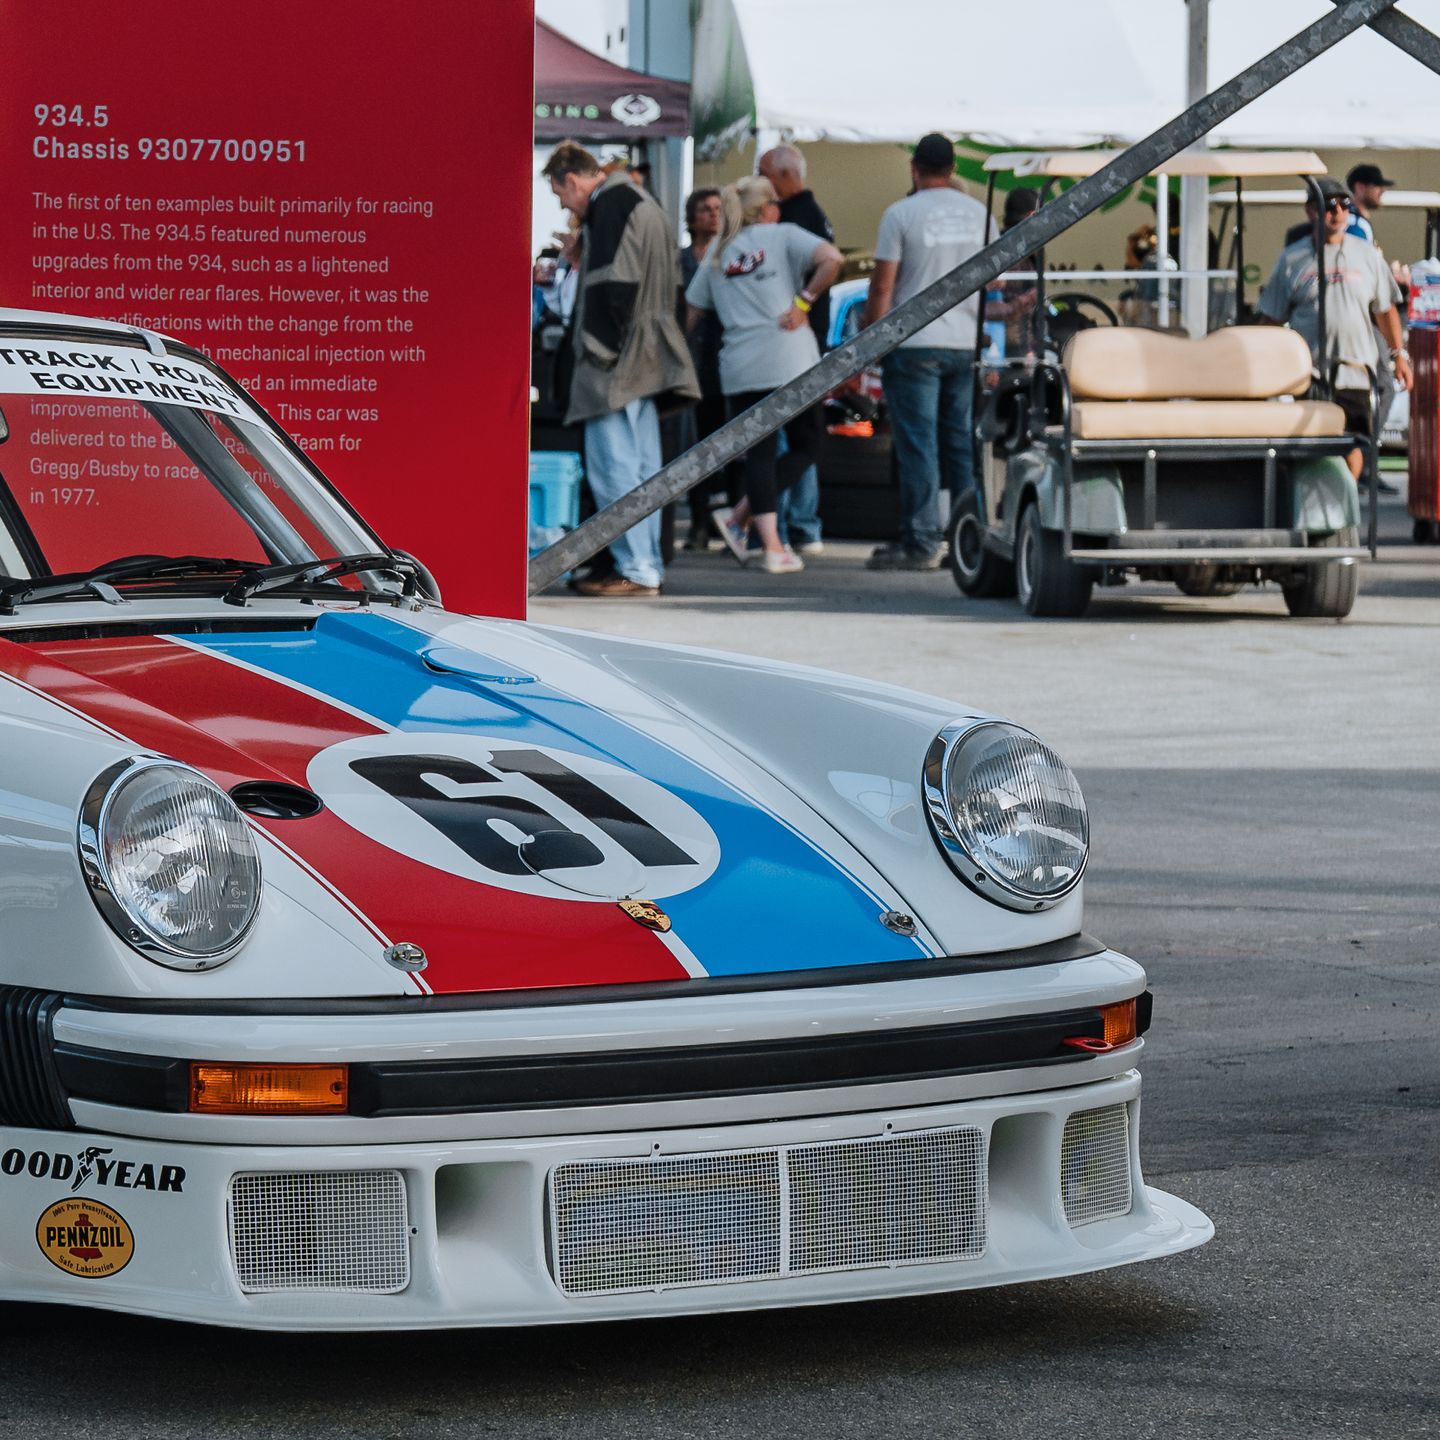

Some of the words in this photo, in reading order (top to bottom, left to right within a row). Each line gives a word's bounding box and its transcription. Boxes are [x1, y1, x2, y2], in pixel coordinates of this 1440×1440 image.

[34, 103, 109, 128] 934.5
[32, 135, 130, 160] Chassis
[137, 137, 306, 162] 9307700951
[31, 191, 63, 210] The
[67, 192, 100, 211] first
[104, 193, 121, 211] of
[124, 195, 152, 212] ten
[156, 195, 234, 216] examples
[239, 195, 276, 213] built
[280, 196, 352, 218] primarily
[356, 197, 379, 214] for
[383, 197, 433, 218] racing
[32, 221, 47, 239] in
[52, 222, 79, 240] the
[83, 223, 116, 241] U.S.
[120, 223, 151, 241] The
[155, 224, 206, 242] 934.5
[211, 225, 280, 243] featured
[284, 228, 367, 243] numerous
[32, 253, 109, 273] upgrades
[113, 253, 152, 271] from
[157, 254, 183, 271] the
[188, 254, 228, 274] 934,
[231, 256, 270, 272] such
[274, 259, 293, 273] as
[297, 259, 307, 273] a
[312, 256, 389, 277] lightened
[31, 281, 91, 299] interior
[95, 282, 125, 300] and
[129, 283, 174, 301] wider
[179, 287, 211, 301] rear
[215, 284, 264, 302] flares.
[269, 285, 345, 305] However,
[349, 286, 361, 303] it
[364, 289, 398, 303] was
[402, 286, 429, 303] the
[93, 312, 202, 331] difications
[207, 314, 242, 332] with
[247, 315, 274, 332] the
[278, 315, 339, 336] change
[343, 315, 382, 333] from
[386, 315, 414, 333] the
[216, 344, 310, 362] mechanical
[314, 345, 385, 366] injection
[390, 345, 426, 362] with
[147, 361, 240, 401] ROAD
[265, 378, 285, 391] an
[290, 374, 378, 392] immediate
[30, 372, 241, 415] EQUIPMENT
[30, 399, 140, 422] improvement
[277, 403, 311, 421] This
[316, 407, 341, 421] car
[346, 407, 379, 422] was
[30, 429, 105, 447] delivered
[109, 434, 126, 448] to
[130, 431, 157, 448] the
[290, 433, 334, 451] Team
[339, 434, 362, 451] for
[30, 457, 140, 481] Gregg/Busby
[144, 464, 160, 478] to
[164, 465, 200, 479] race
[30, 487, 44, 505] in
[51, 487, 100, 506] 1977.
[347, 748, 700, 876] 61
[66, 1203, 81, 1212] Pure
[81, 1202, 118, 1225] Pennsylvania
[46, 1226, 125, 1248] PENNZOIL
[58, 1254, 74, 1270] Safe
[75, 1262, 114, 1274] Lubrication
